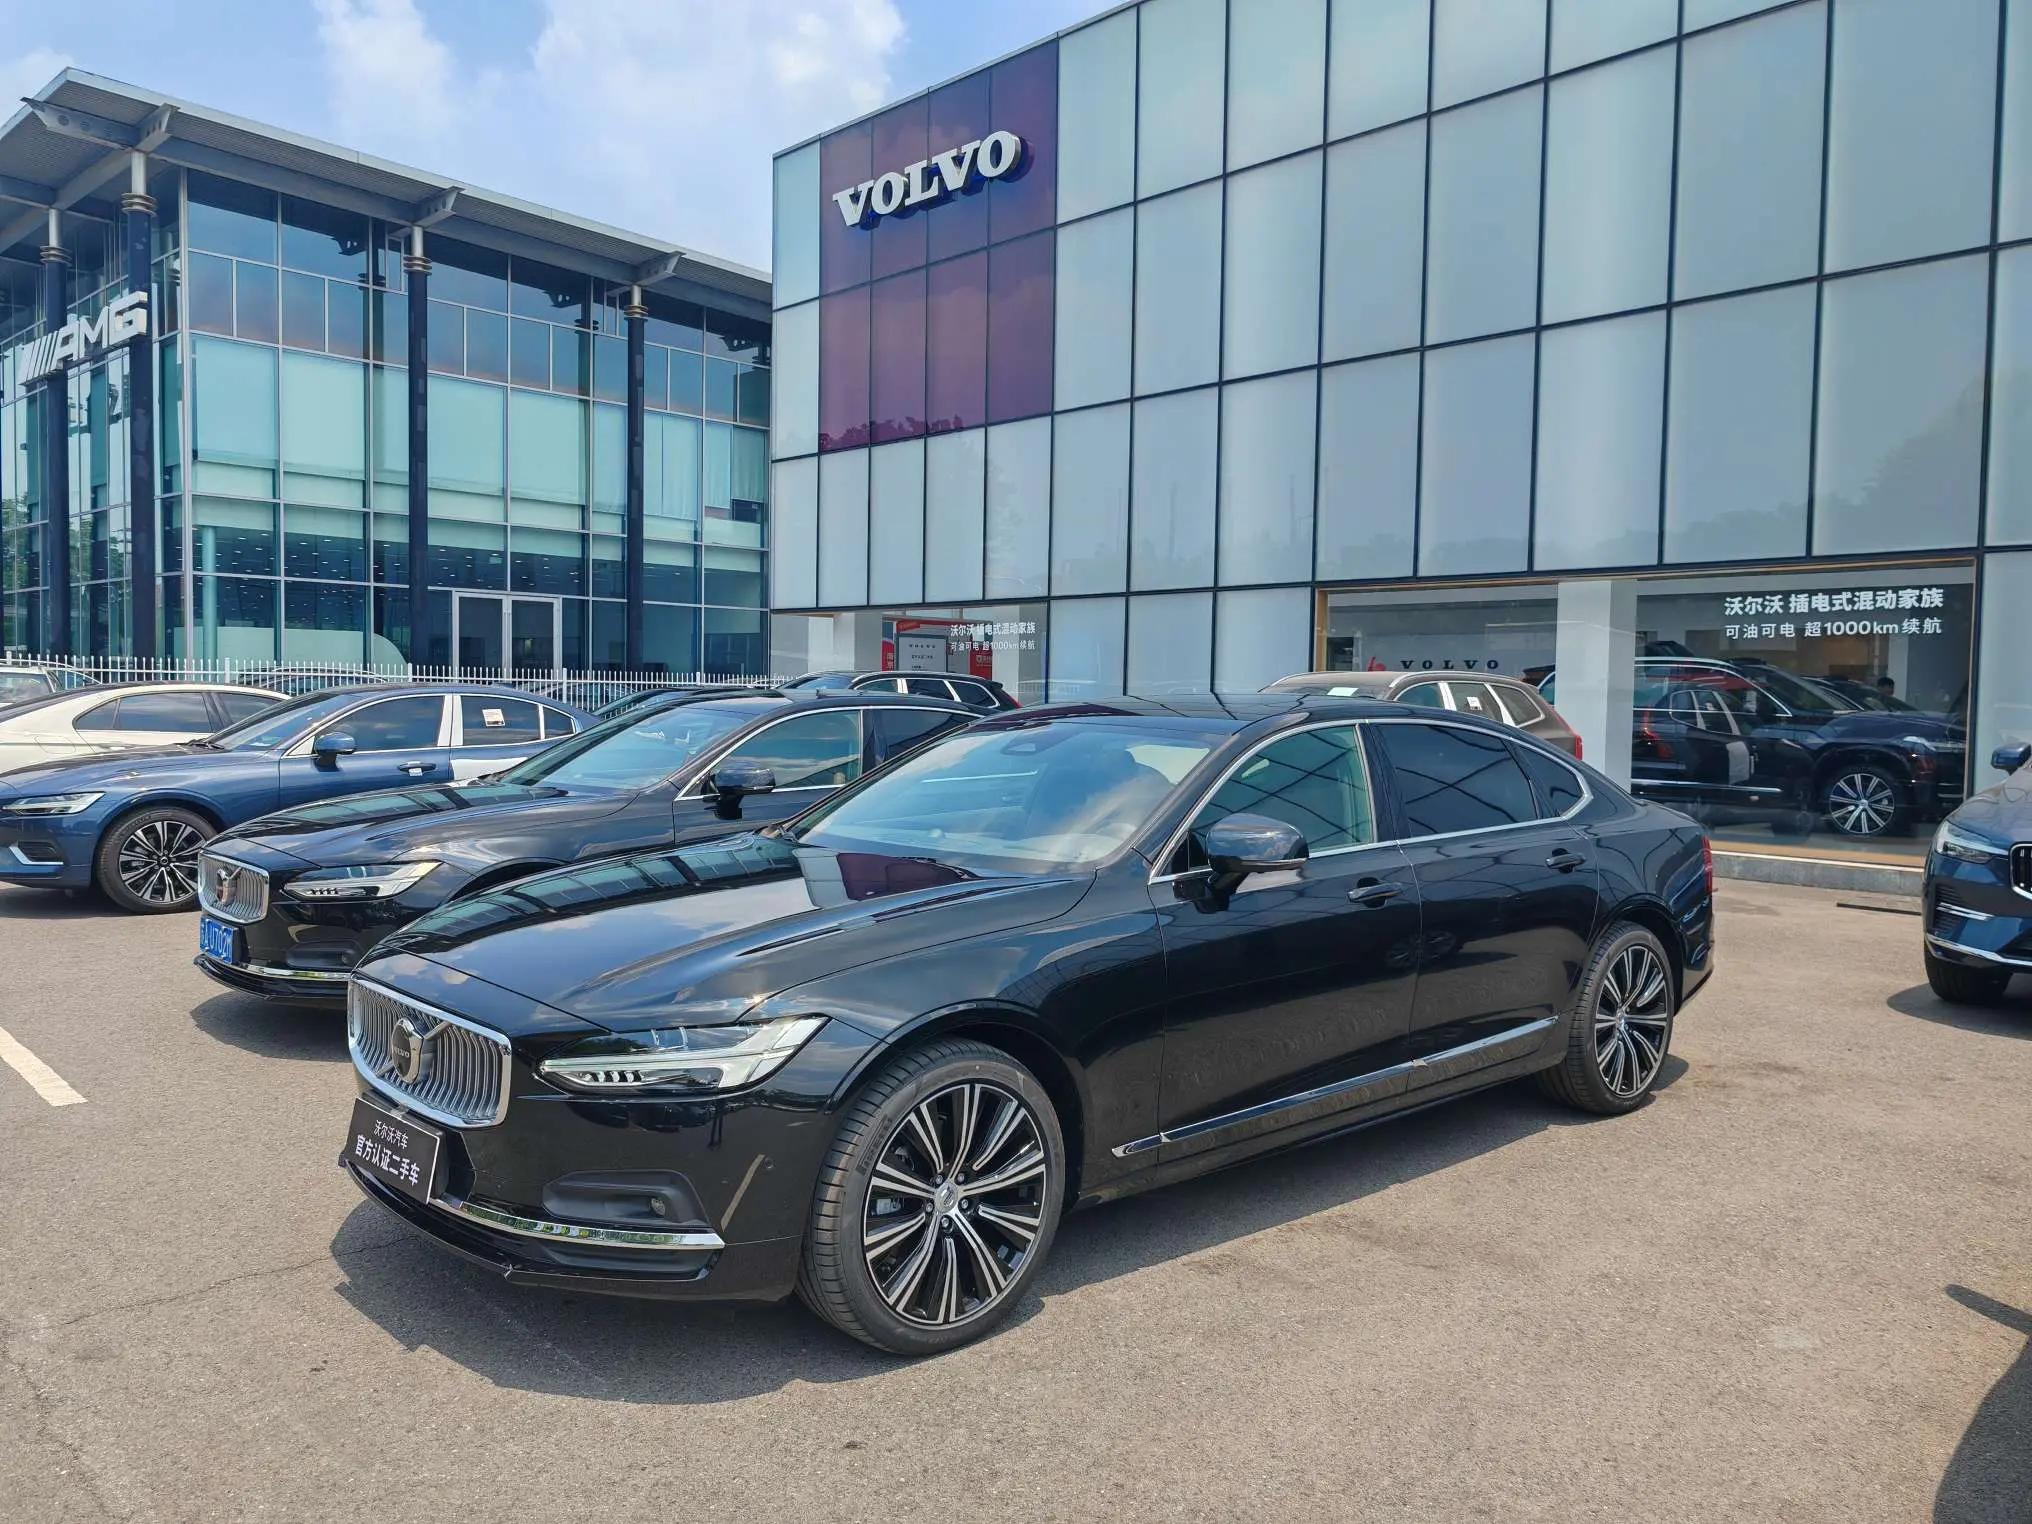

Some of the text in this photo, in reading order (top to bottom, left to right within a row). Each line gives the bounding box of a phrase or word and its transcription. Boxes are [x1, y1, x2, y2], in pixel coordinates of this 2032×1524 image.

[832, 130, 1021, 227] VOLVO
[50, 291, 148, 371] AMG
[1724, 588, 1944, 616] 沃尔沃 插电式混动家族
[1725, 616, 1942, 640] 可油可电 超1000km续航
[1400, 659, 1499, 670] VOLVO
[373, 1119, 409, 1150] 沃尔沃汽车
[355, 1134, 420, 1187] 官方认证二手车
